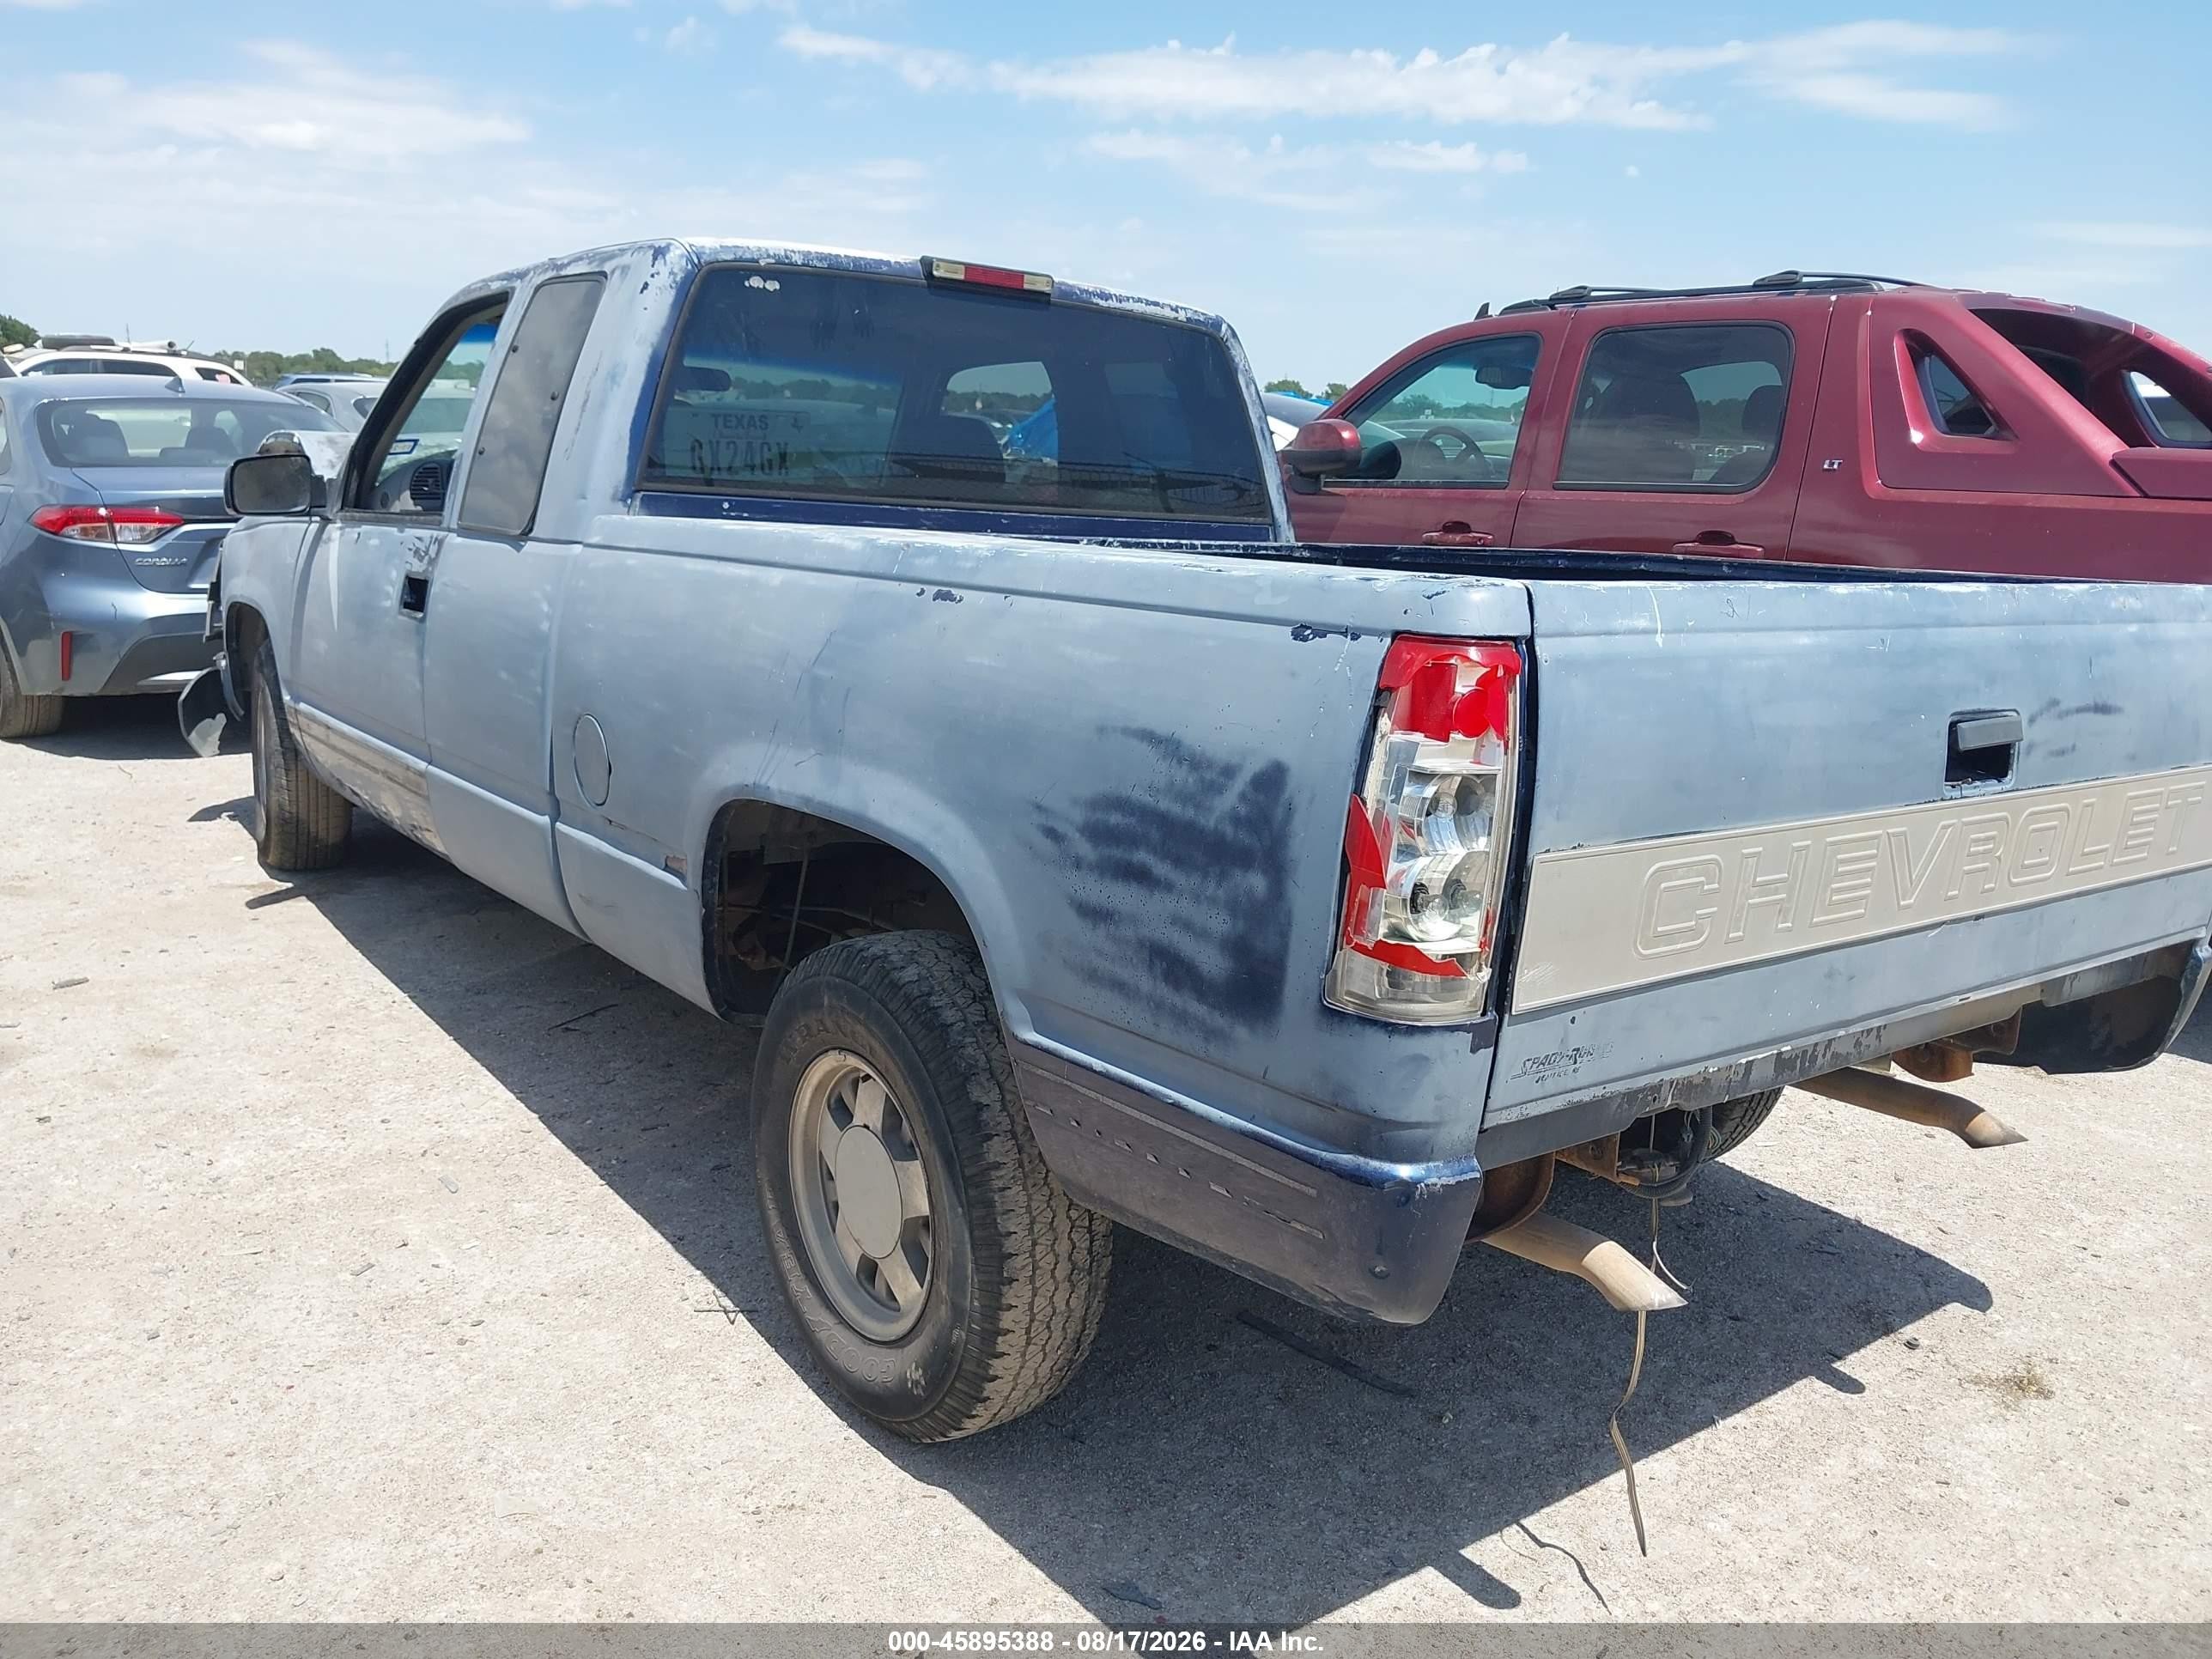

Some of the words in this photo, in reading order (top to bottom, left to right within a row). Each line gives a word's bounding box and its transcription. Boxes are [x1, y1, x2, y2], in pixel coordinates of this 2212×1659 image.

[709, 413, 769, 430] TEXAS
[1823, 459, 1843, 470] LT
[1633, 780, 2207, 960] CHEVROLET
